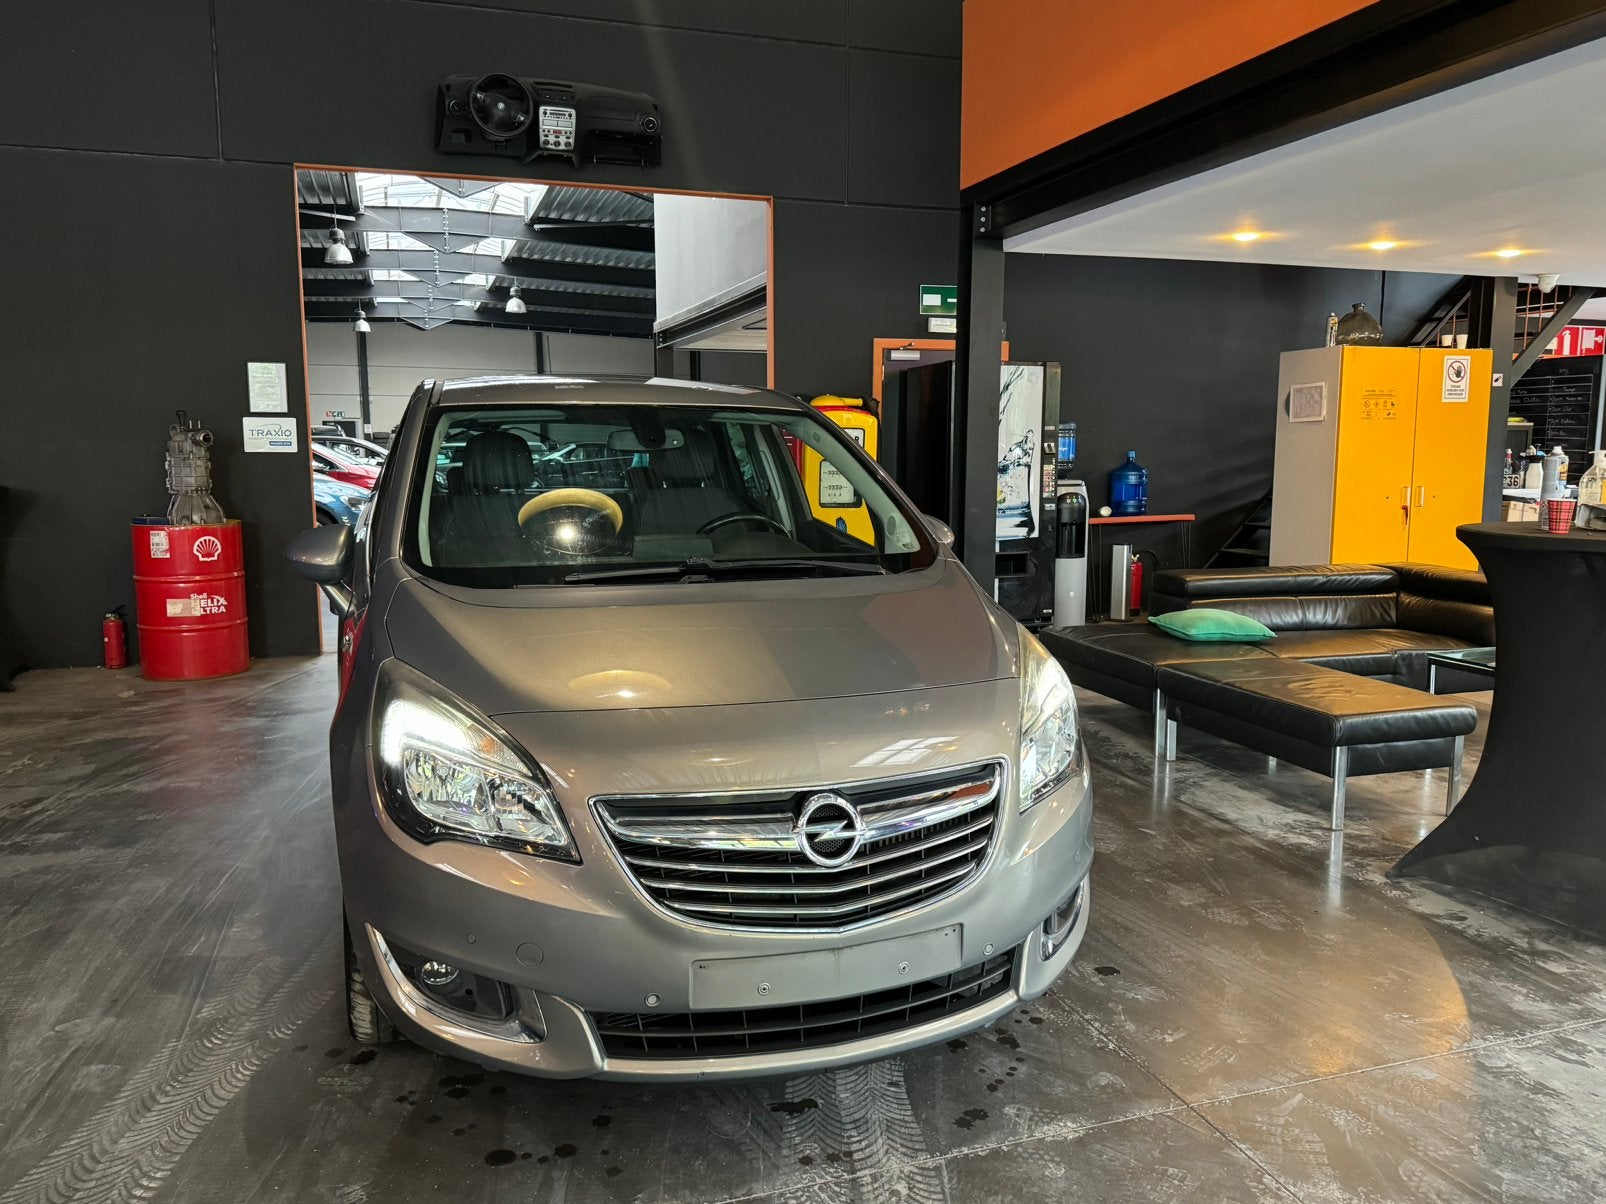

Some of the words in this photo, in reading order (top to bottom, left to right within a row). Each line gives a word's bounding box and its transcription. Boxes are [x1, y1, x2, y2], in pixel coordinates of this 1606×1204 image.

[249, 429, 292, 437] TRAXIO
[200, 597, 228, 607] ELIX
[200, 606, 226, 614] LTRA
